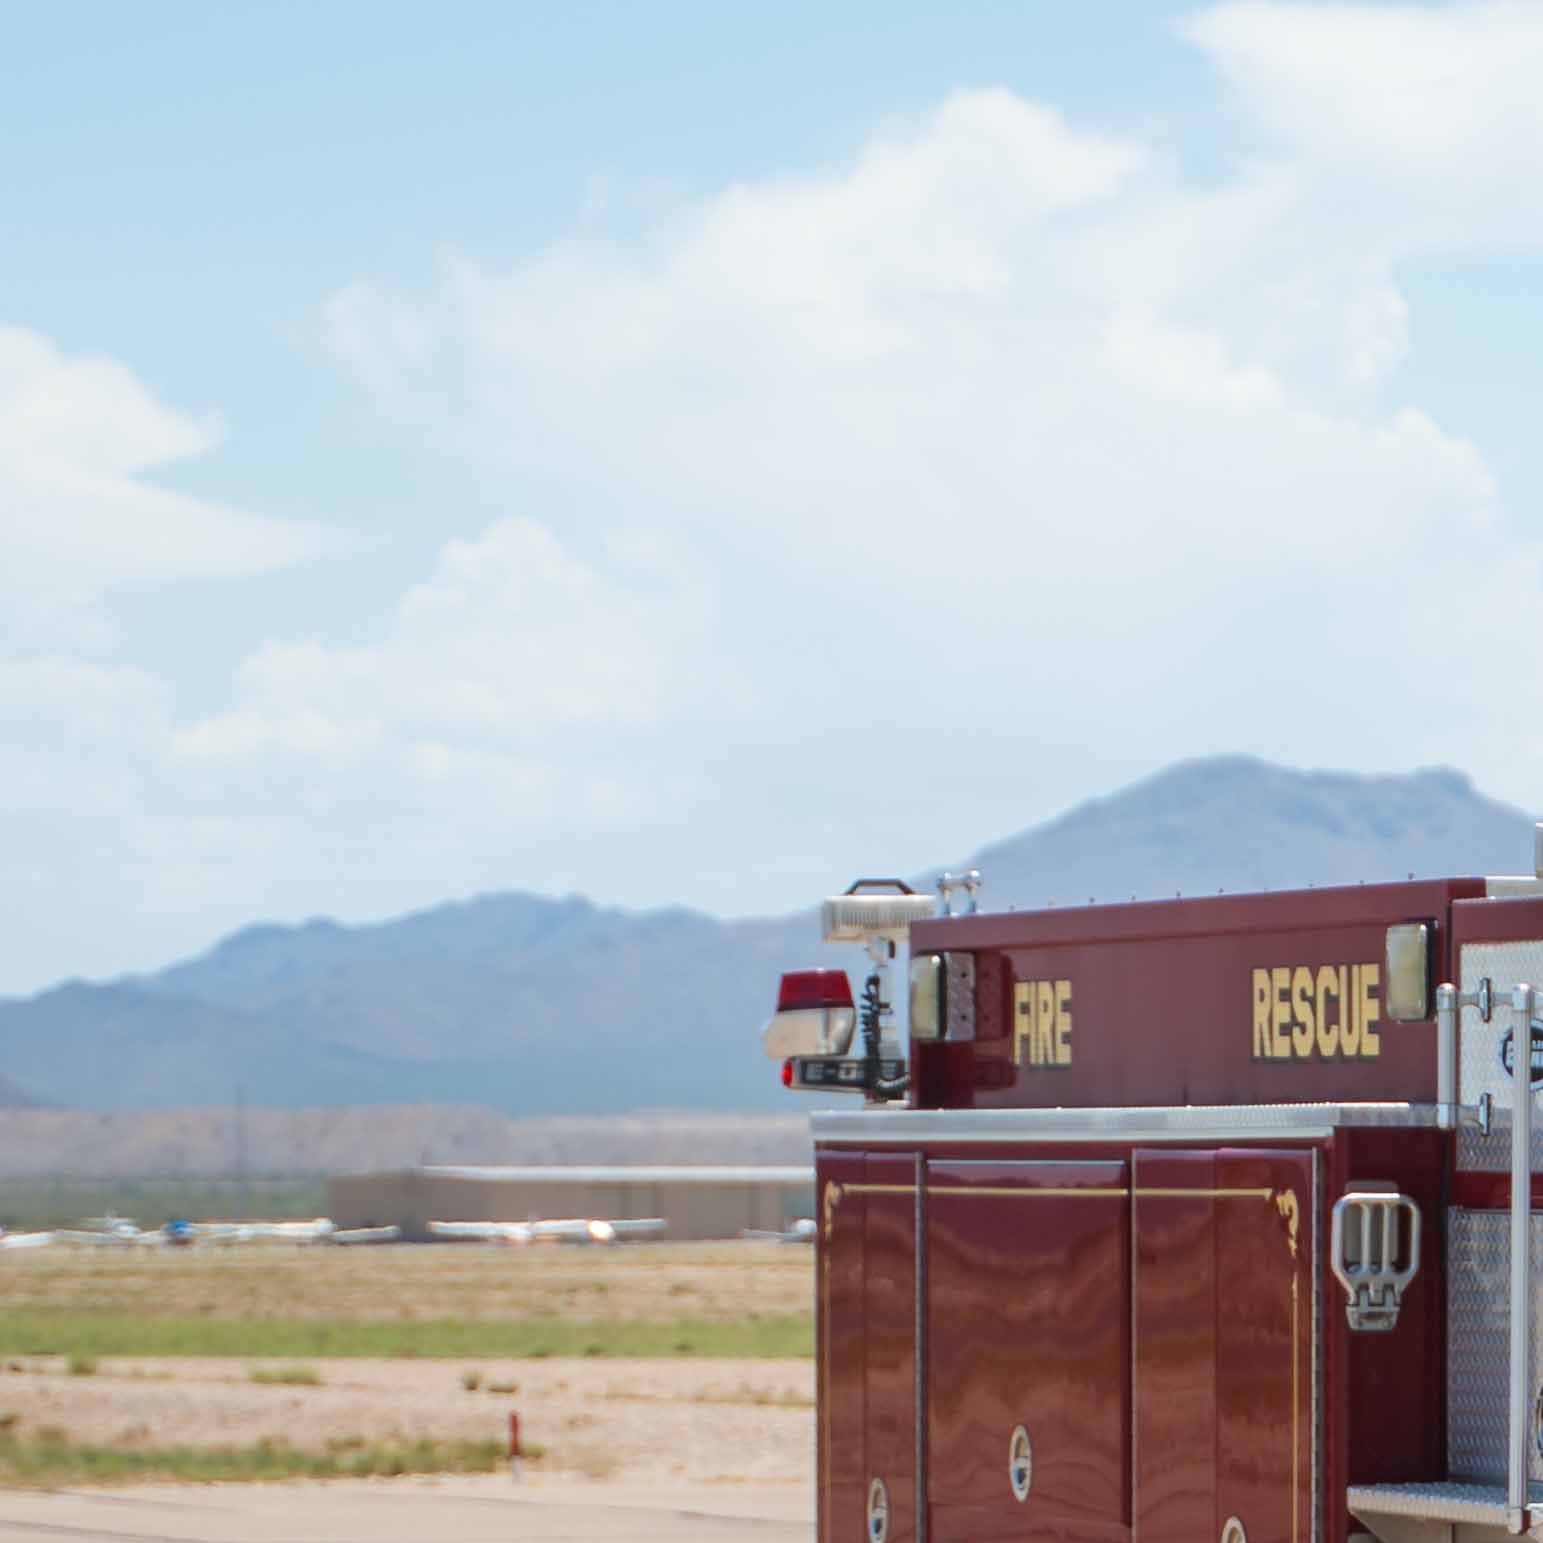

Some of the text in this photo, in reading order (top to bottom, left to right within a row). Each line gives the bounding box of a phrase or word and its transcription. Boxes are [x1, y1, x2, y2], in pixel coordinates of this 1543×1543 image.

[1014, 980, 1072, 1065] FIRE
[1252, 963, 1381, 1058] RESCUE
[804, 1062, 898, 1082] E-OE
